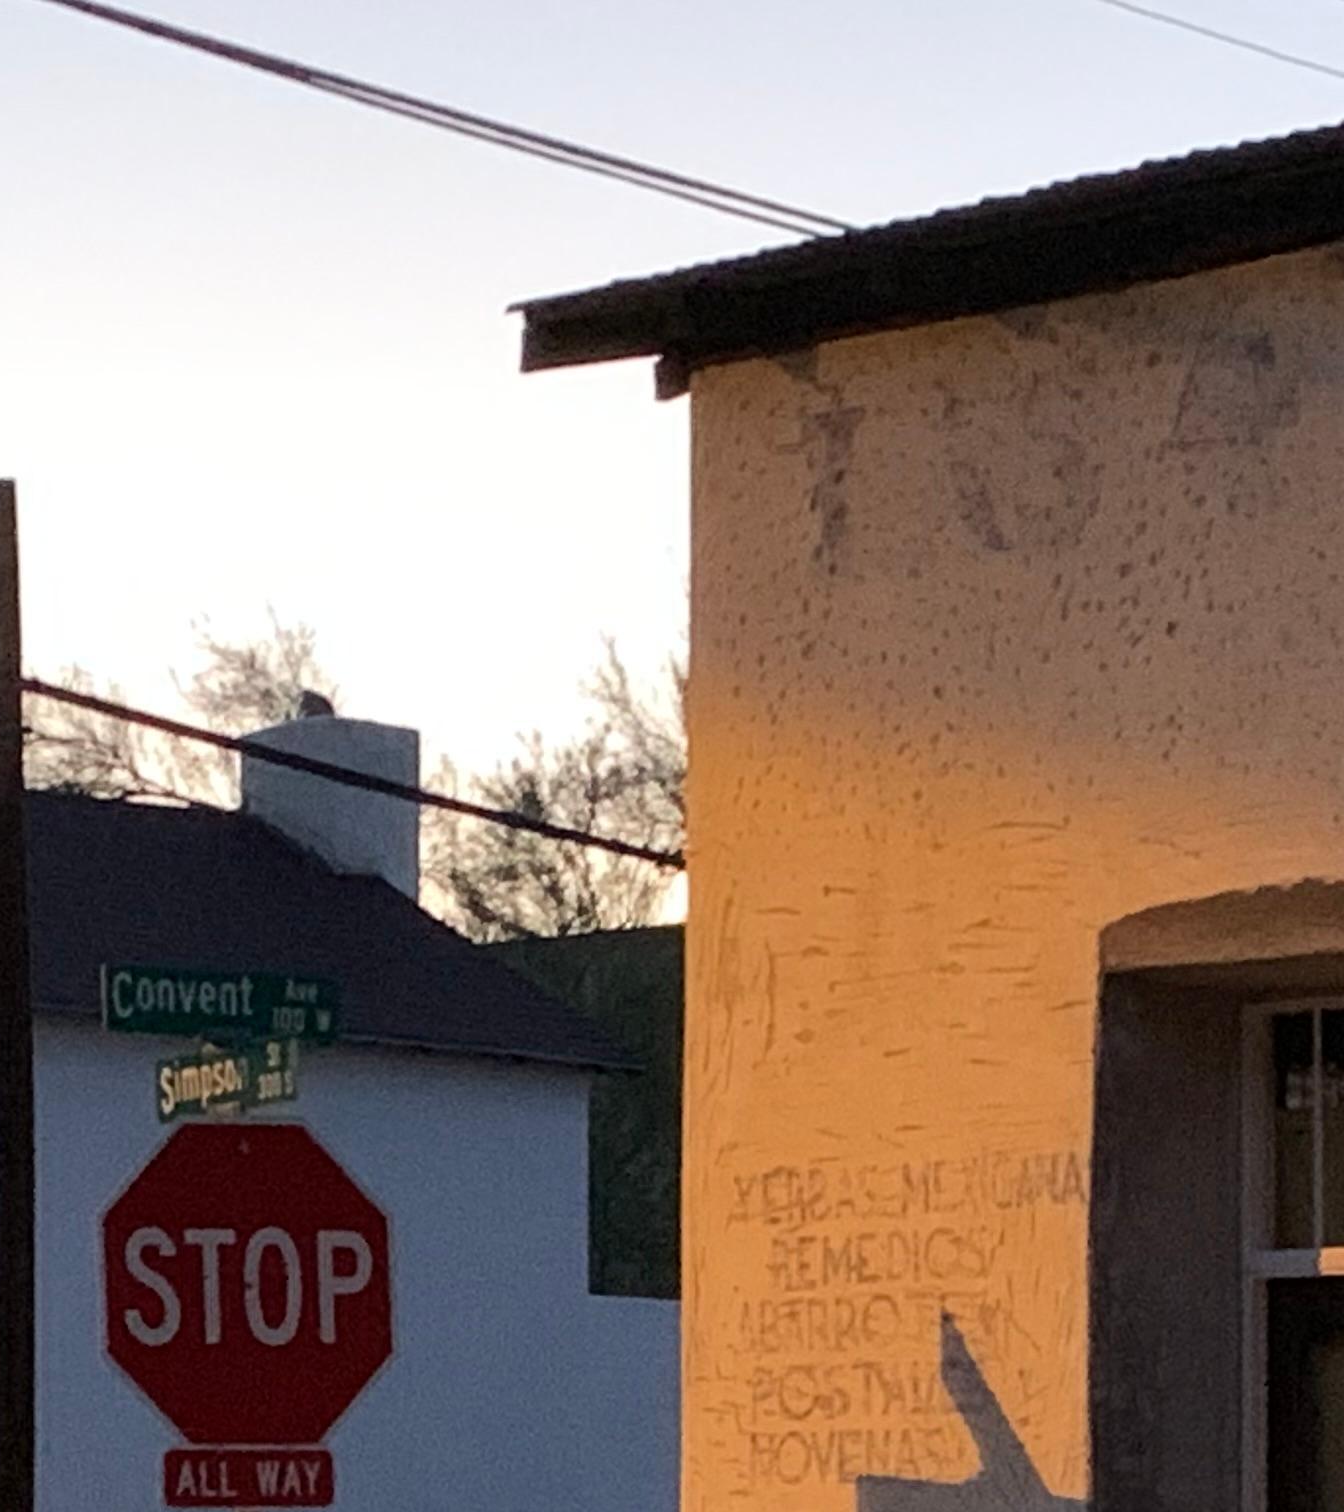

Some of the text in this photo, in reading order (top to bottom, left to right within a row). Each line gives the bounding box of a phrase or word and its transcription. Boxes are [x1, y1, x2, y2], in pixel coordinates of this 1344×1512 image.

[111, 970, 254, 1019] Convent
[285, 979, 319, 1004] Ave
[123, 1225, 374, 1348] STOP
[175, 1459, 324, 1498] ALL WAY
